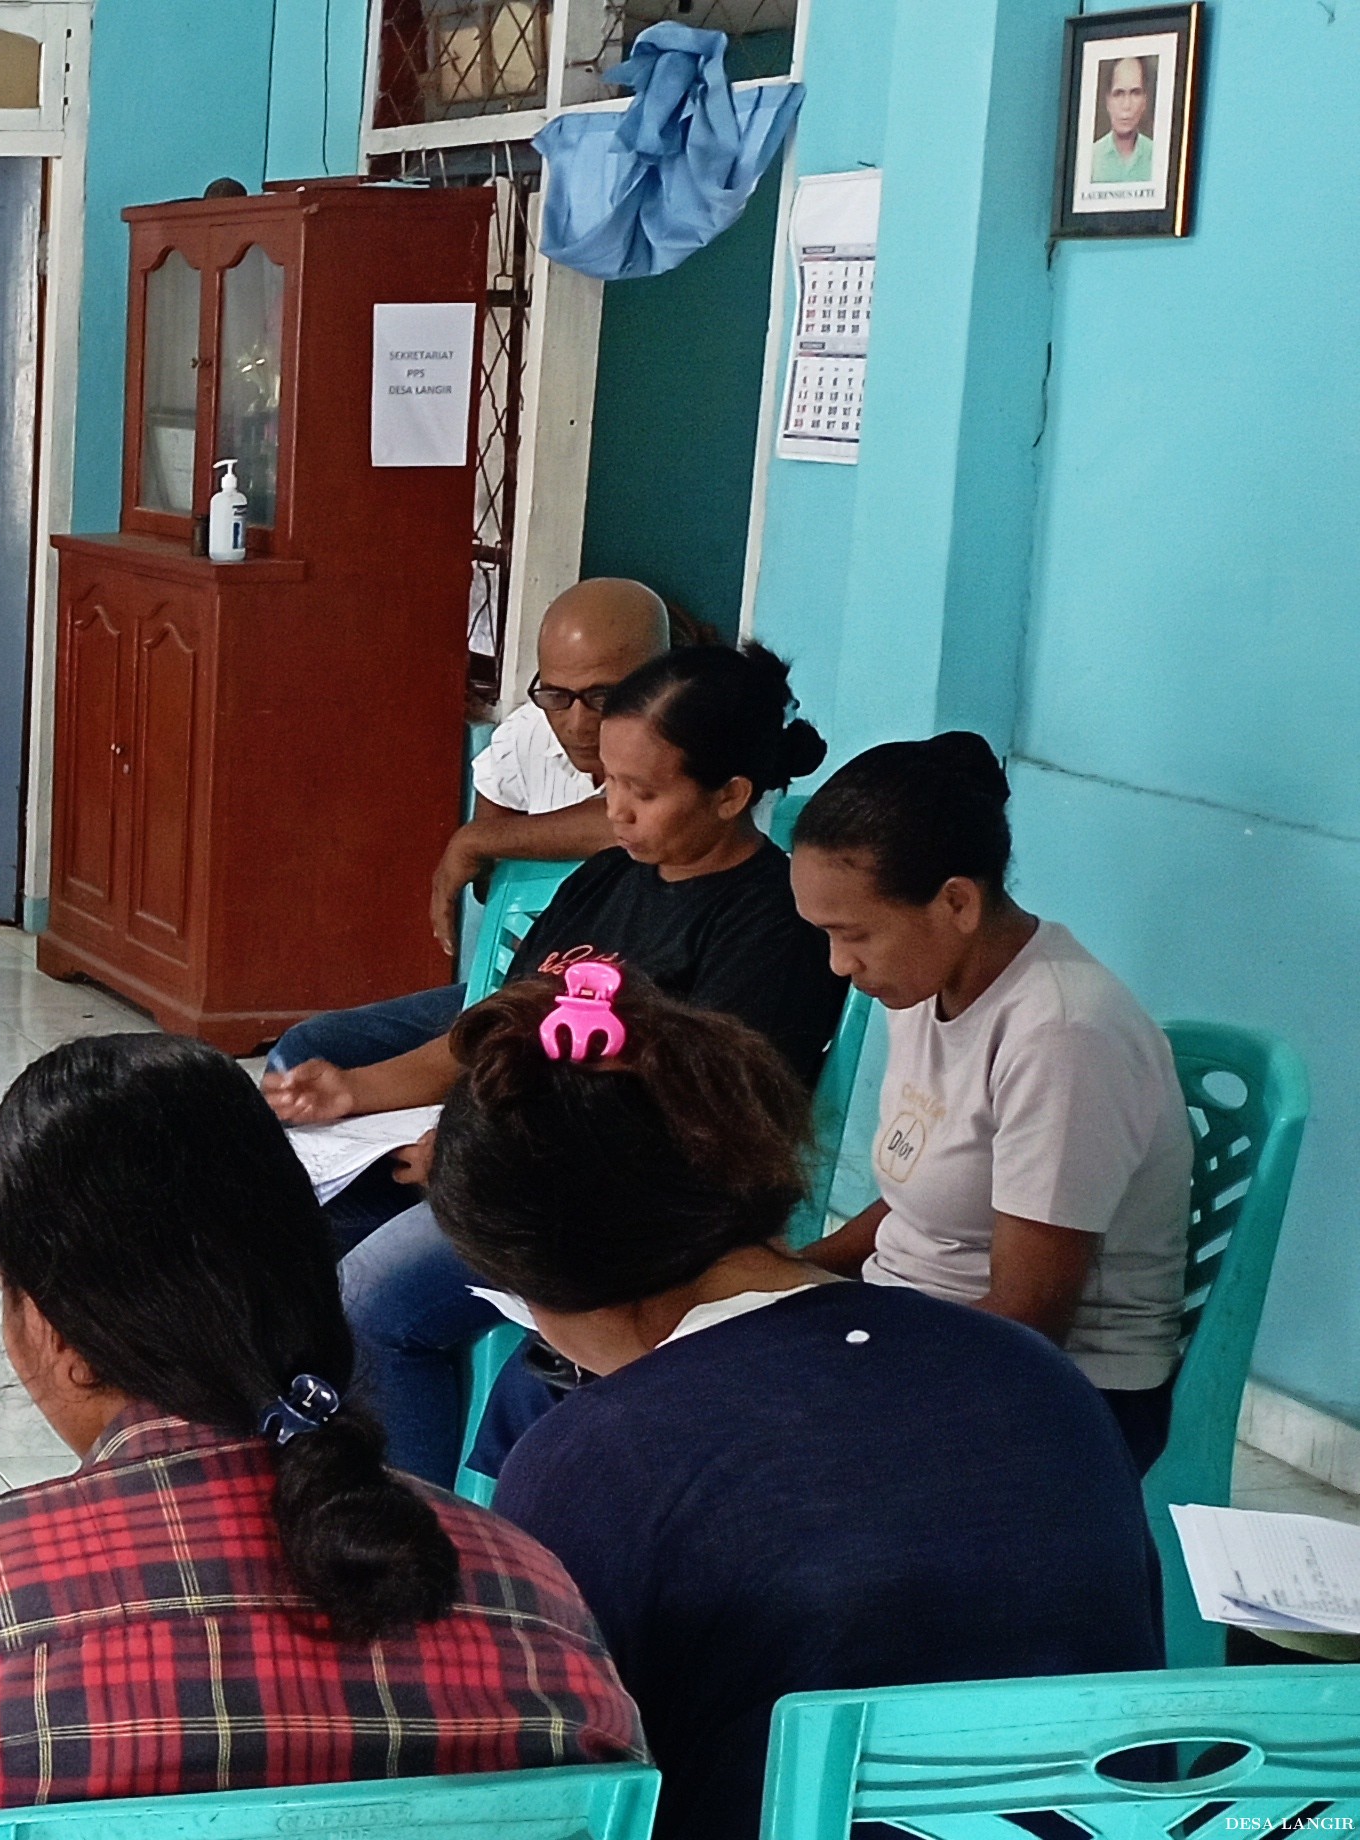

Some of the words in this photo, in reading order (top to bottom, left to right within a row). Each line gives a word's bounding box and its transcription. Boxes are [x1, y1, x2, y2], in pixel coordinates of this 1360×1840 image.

[389, 350, 454, 361] SEKRETARIAT
[406, 368, 426, 378] PPS
[388, 385, 413, 395] DESA
[415, 385, 452, 395] LANGIR
